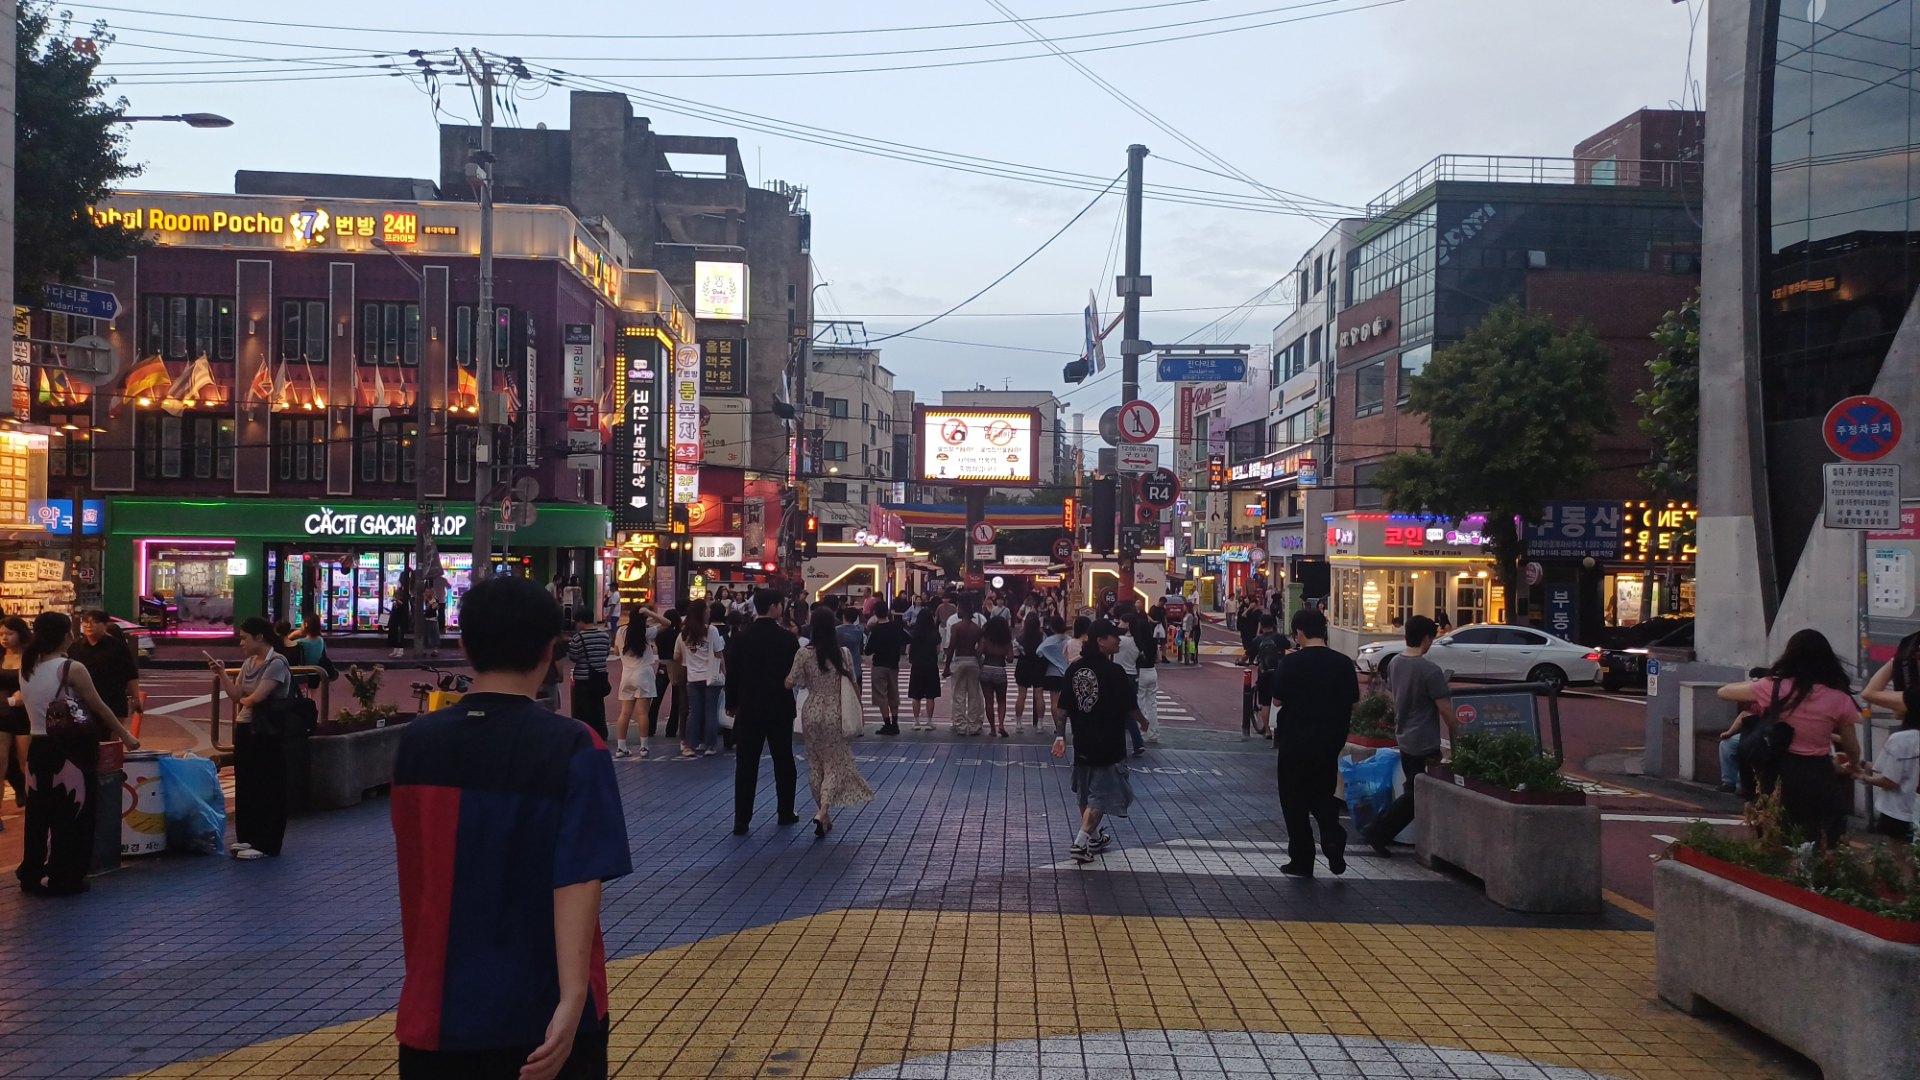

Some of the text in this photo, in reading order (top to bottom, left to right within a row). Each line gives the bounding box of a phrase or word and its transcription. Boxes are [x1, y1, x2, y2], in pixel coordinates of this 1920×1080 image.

[149, 208, 210, 231] Room
[213, 210, 283, 234] Pocha
[335, 216, 376, 236] 번방
[384, 214, 416, 234] 24H
[47, 302, 89, 313] ndari-ro
[101, 301, 113, 311] 18
[705, 356, 732, 368] 맥주
[1187, 360, 1217, 368] 잔다리로
[573, 345, 584, 396] 코인노래방
[1162, 365, 1243, 374] 14 18
[705, 371, 731, 383] 만원
[573, 404, 595, 427] 약
[1836, 422, 1892, 436] 주정차금지
[632, 389, 650, 488] 코인노래연습장
[677, 446, 696, 457] 소주
[679, 476, 693, 487] 2F
[679, 492, 693, 502] 3F
[1149, 486, 1170, 500] R4
[360, 514, 417, 535] GACHA
[1384, 527, 1423, 547] 코인
[699, 546, 731, 557] CLUB JAM
